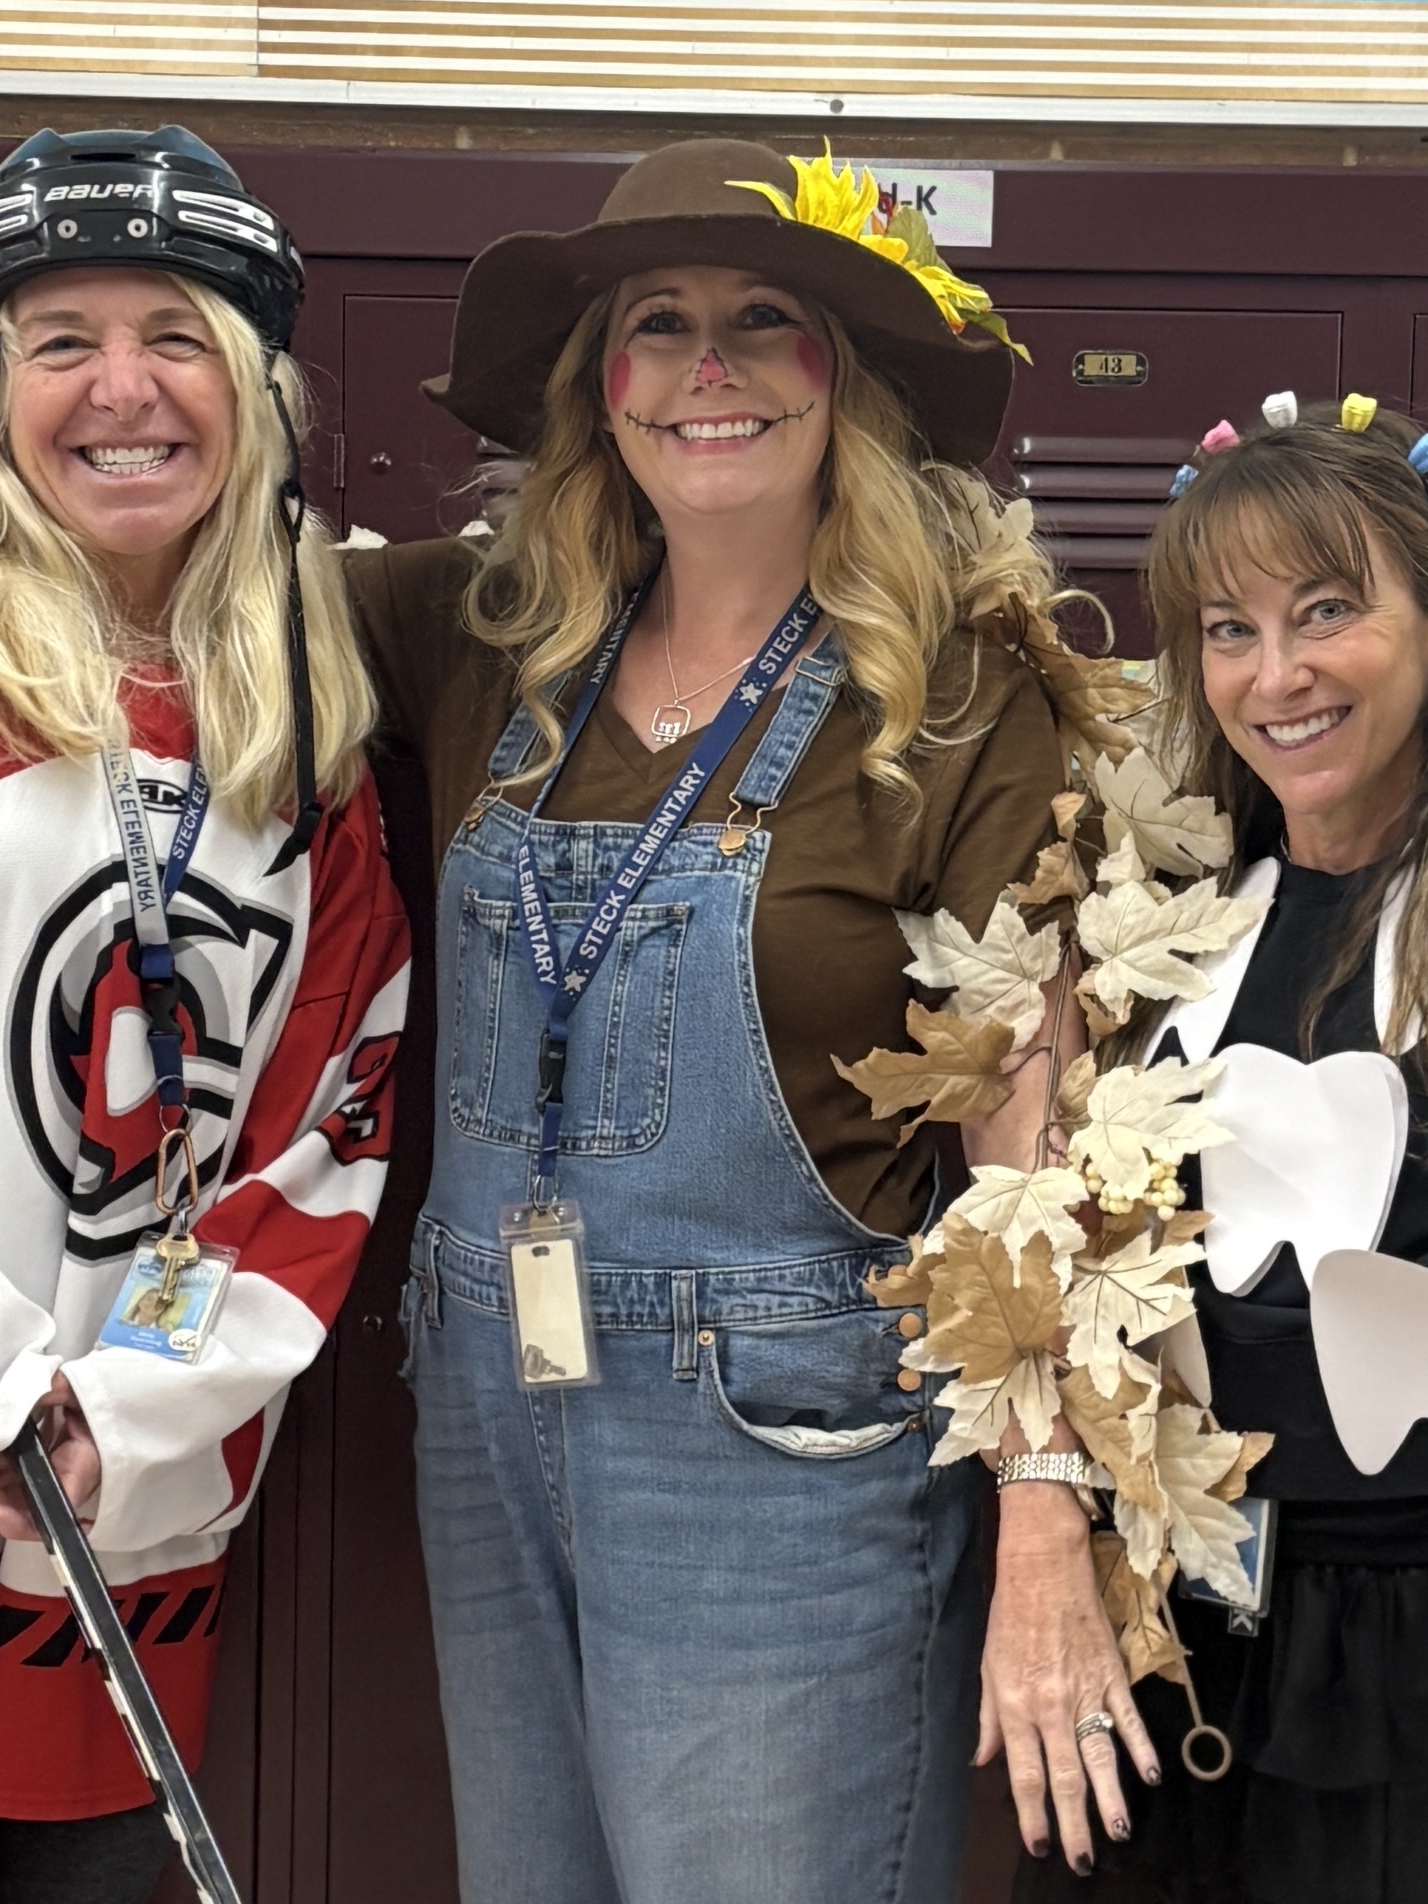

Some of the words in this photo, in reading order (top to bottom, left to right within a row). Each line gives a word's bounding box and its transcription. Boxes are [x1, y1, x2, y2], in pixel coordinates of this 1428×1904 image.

[759, 612, 809, 676] STECK
[172, 805, 201, 860] STECK
[579, 889, 627, 960] STECK
[617, 761, 706, 890] ELEMENTARY
[518, 844, 557, 985] ELEMENTARY
